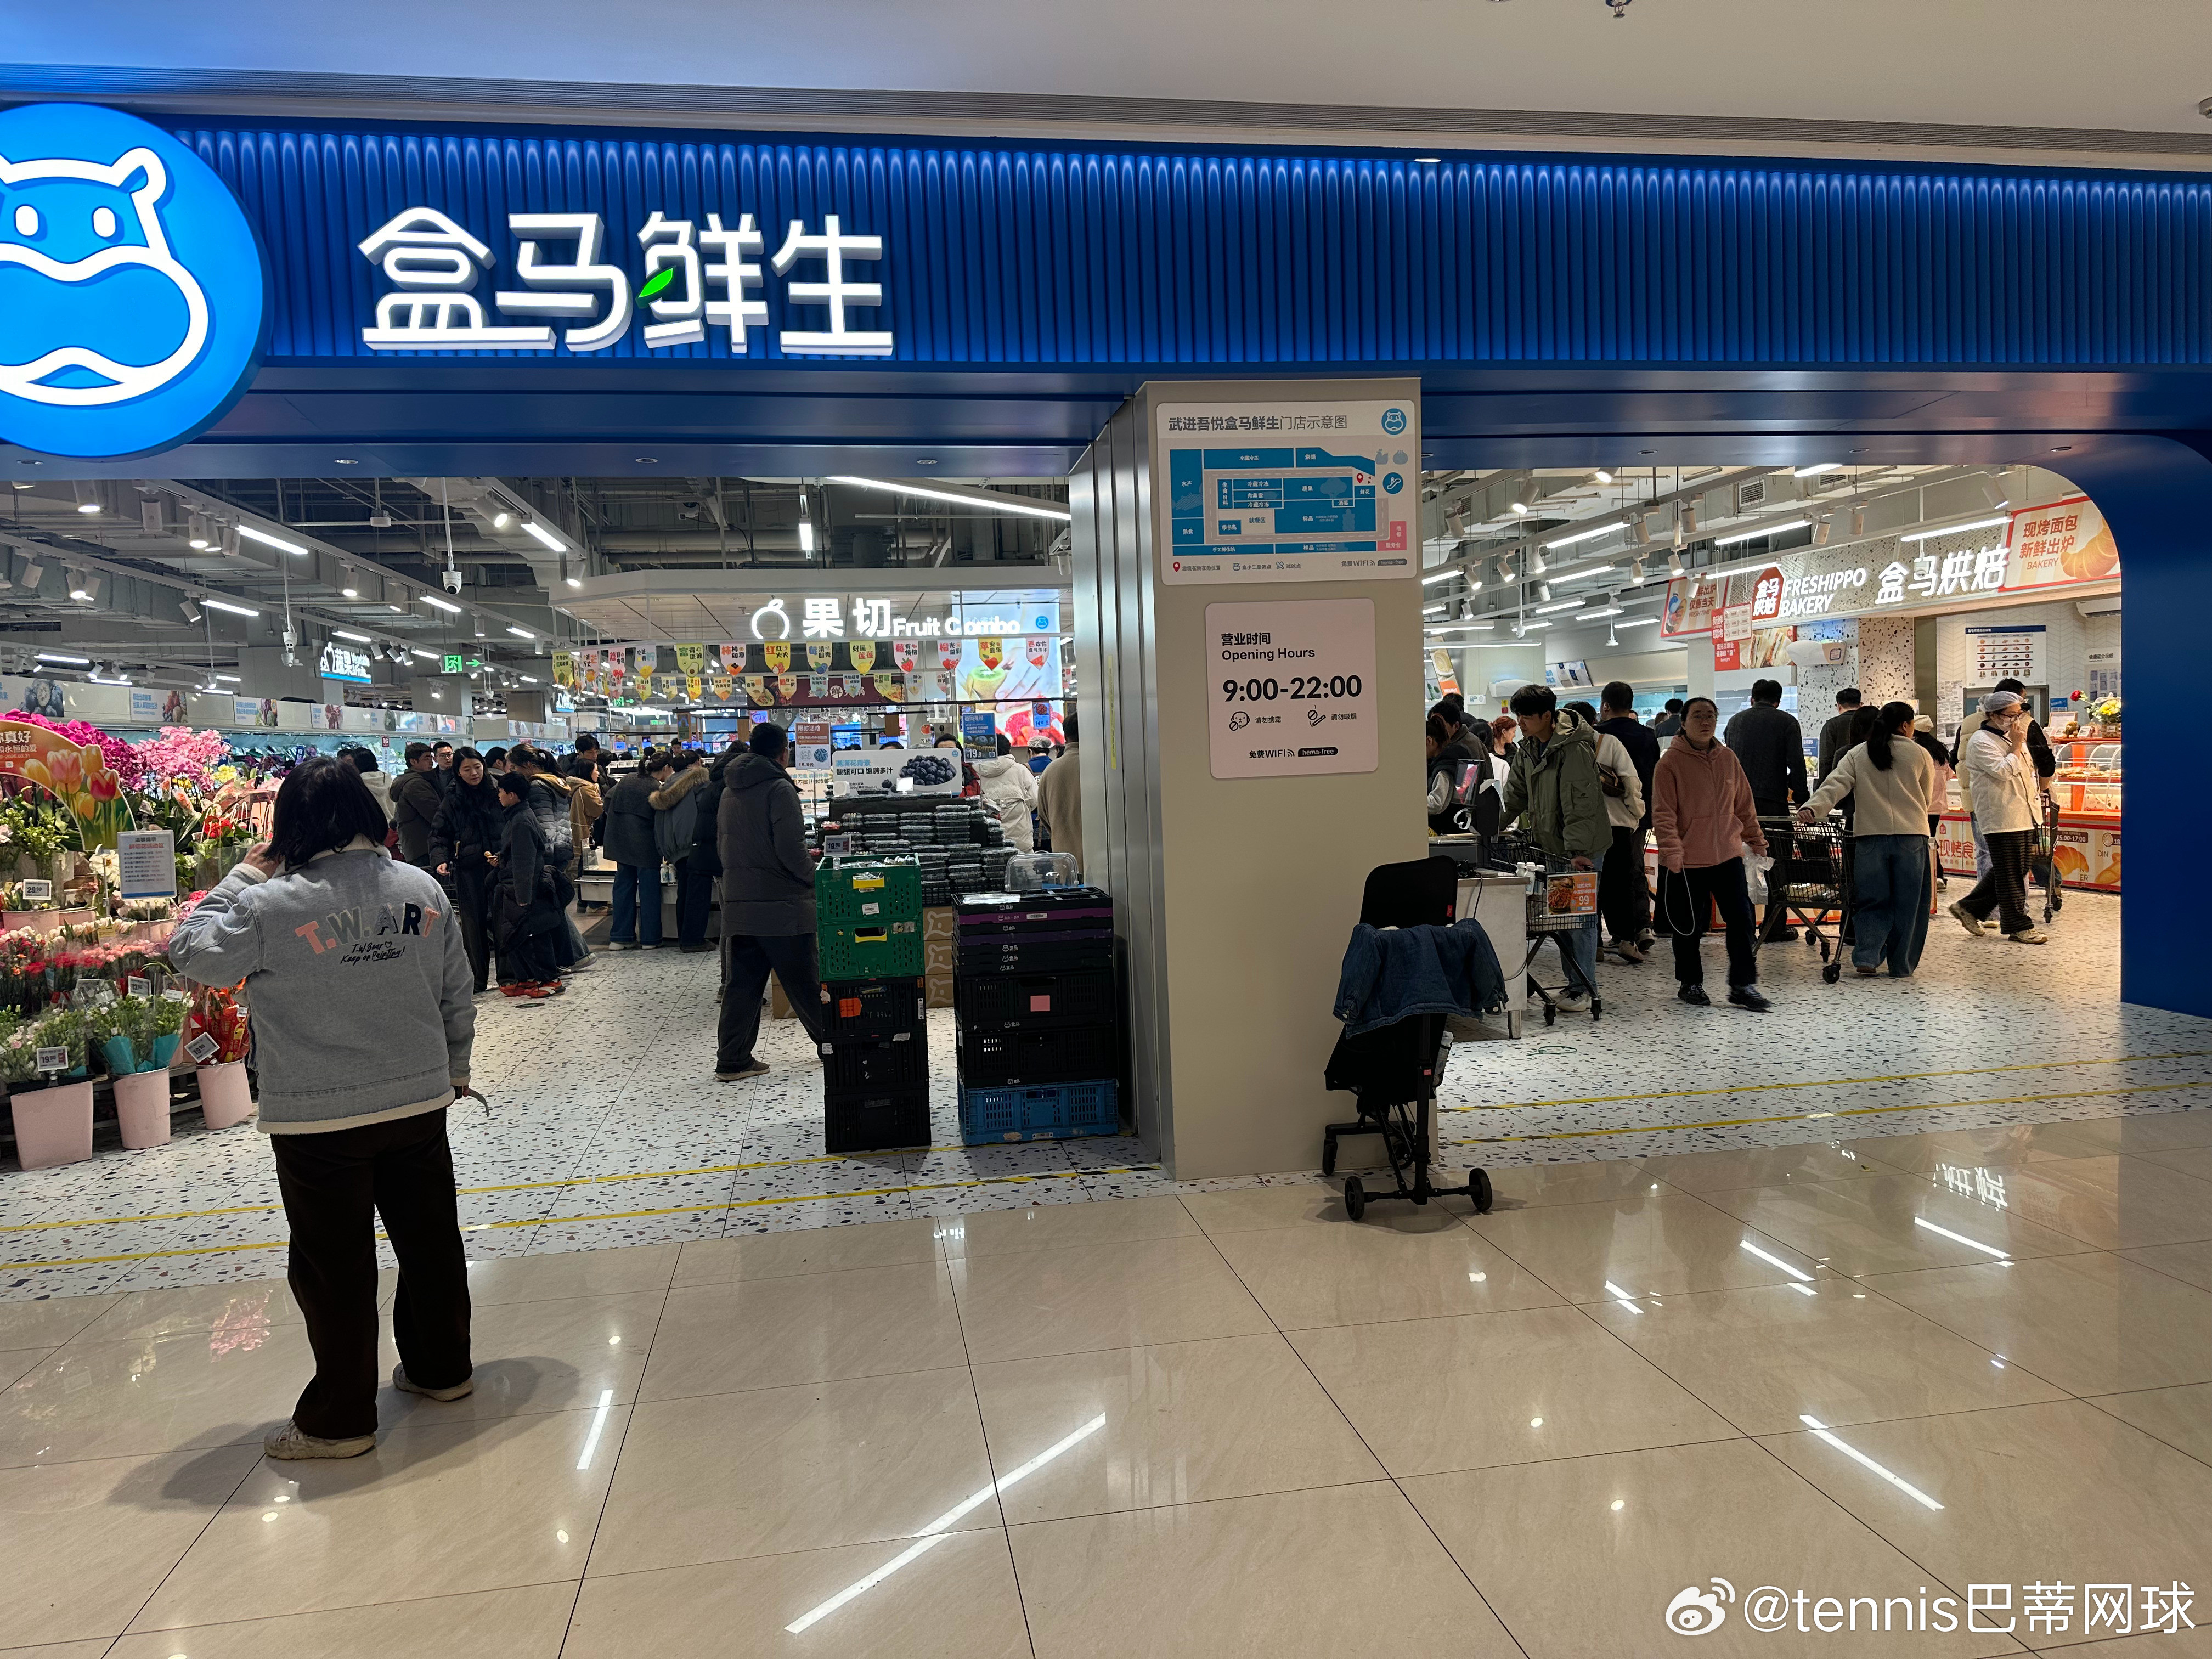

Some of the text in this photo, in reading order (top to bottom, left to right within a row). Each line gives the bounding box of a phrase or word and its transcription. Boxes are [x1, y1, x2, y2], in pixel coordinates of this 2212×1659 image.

[358, 206, 894, 356] 盒马鲜生
[1169, 415, 1347, 431] 武进吾悦盒马鲜生门店示意图
[2022, 515, 2078, 539] 现烤面包
[2020, 535, 2075, 560] 新鲜出炉
[2027, 557, 2059, 571] BAKERY
[1875, 544, 2011, 605] 盒马烘焙
[1756, 578, 1779, 599] 盒马
[1784, 567, 1866, 598] FRESHIPPO
[1689, 596, 1714, 610] 仅售当天
[1780, 593, 1834, 617] BAKERY
[803, 599, 891, 637] 果切
[894, 617, 940, 636] Fruit
[945, 616, 1020, 636] Combo
[1221, 632, 1271, 646] 营业时间
[1222, 647, 1316, 662] Opening Hours
[1222, 675, 1362, 702] 9:00-22:00
[1255, 715, 1282, 724] 请勿携宠
[1330, 713, 1357, 721] 请勿吸烟
[1249, 749, 1286, 759] 免费WIFI
[866, 766, 893, 775] 饱满多汁
[1578, 895, 1590, 905] 99
[340, 953, 361, 966] Keep
